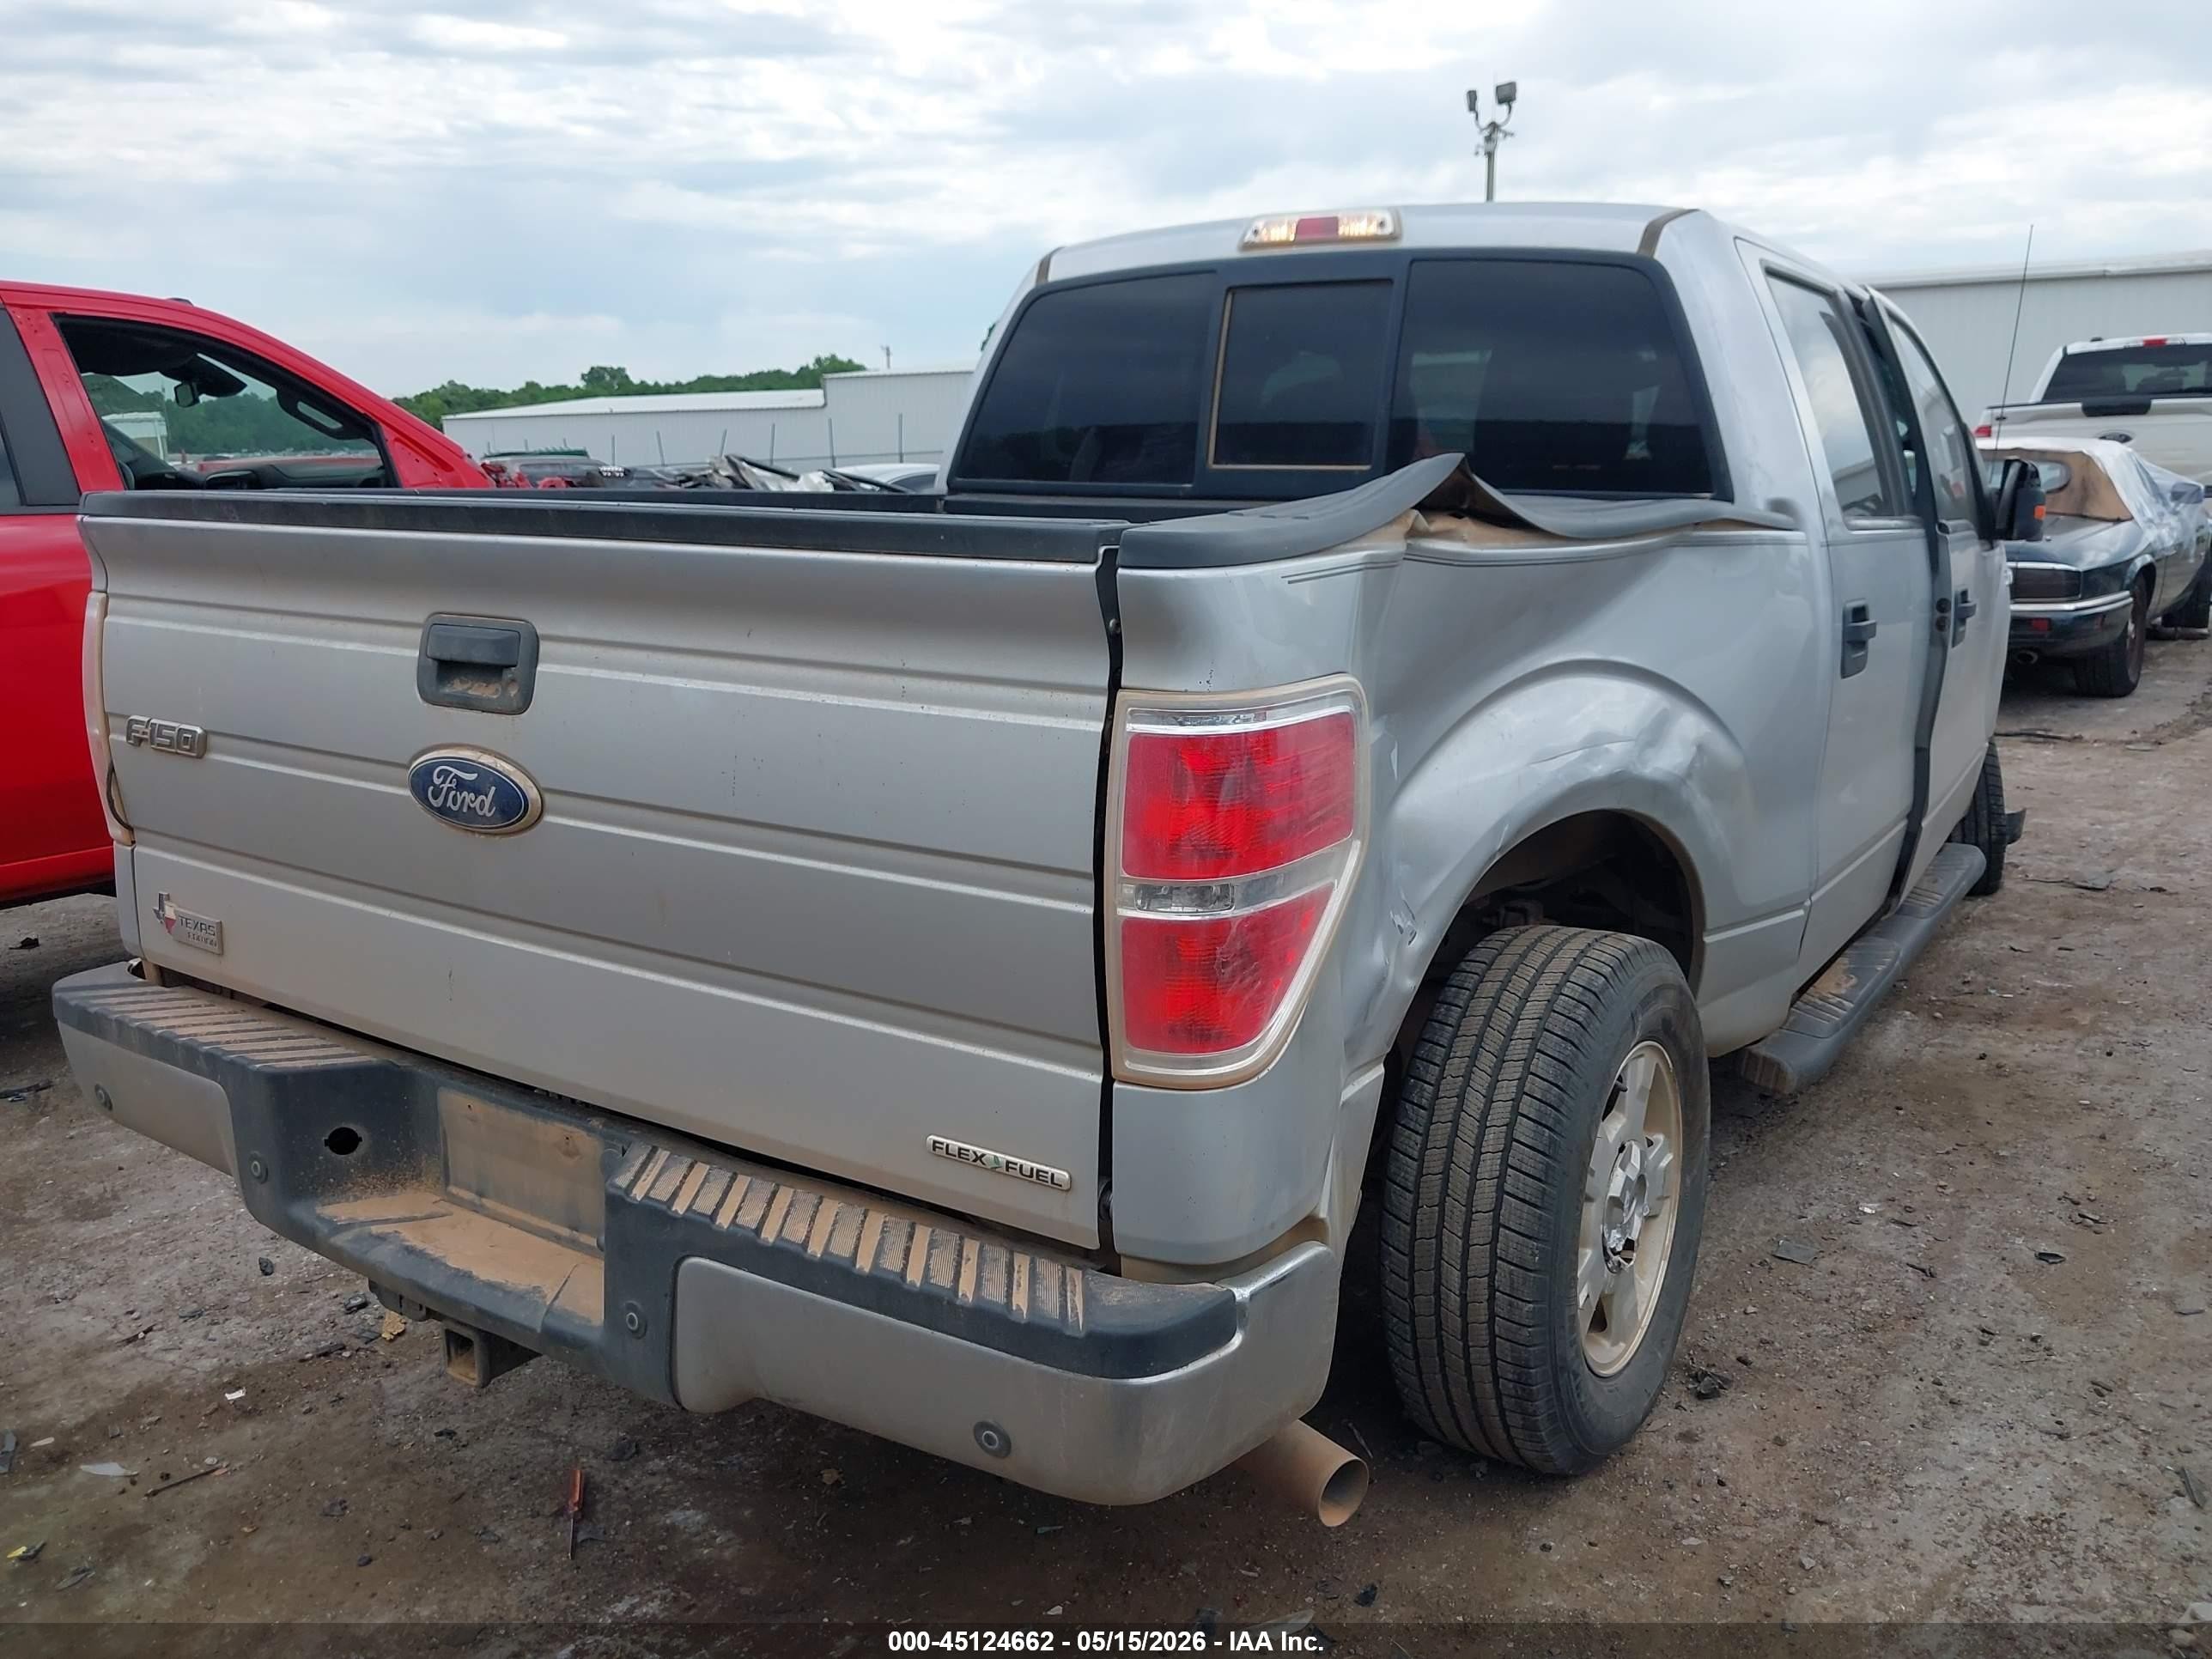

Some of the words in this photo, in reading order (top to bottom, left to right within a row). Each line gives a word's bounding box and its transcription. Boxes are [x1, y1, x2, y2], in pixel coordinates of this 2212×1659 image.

[428, 765, 496, 817] Ford
[178, 915, 216, 936] TEXAS
[932, 1139, 987, 1165] FLEX
[1006, 1160, 1063, 1188] FUEL
